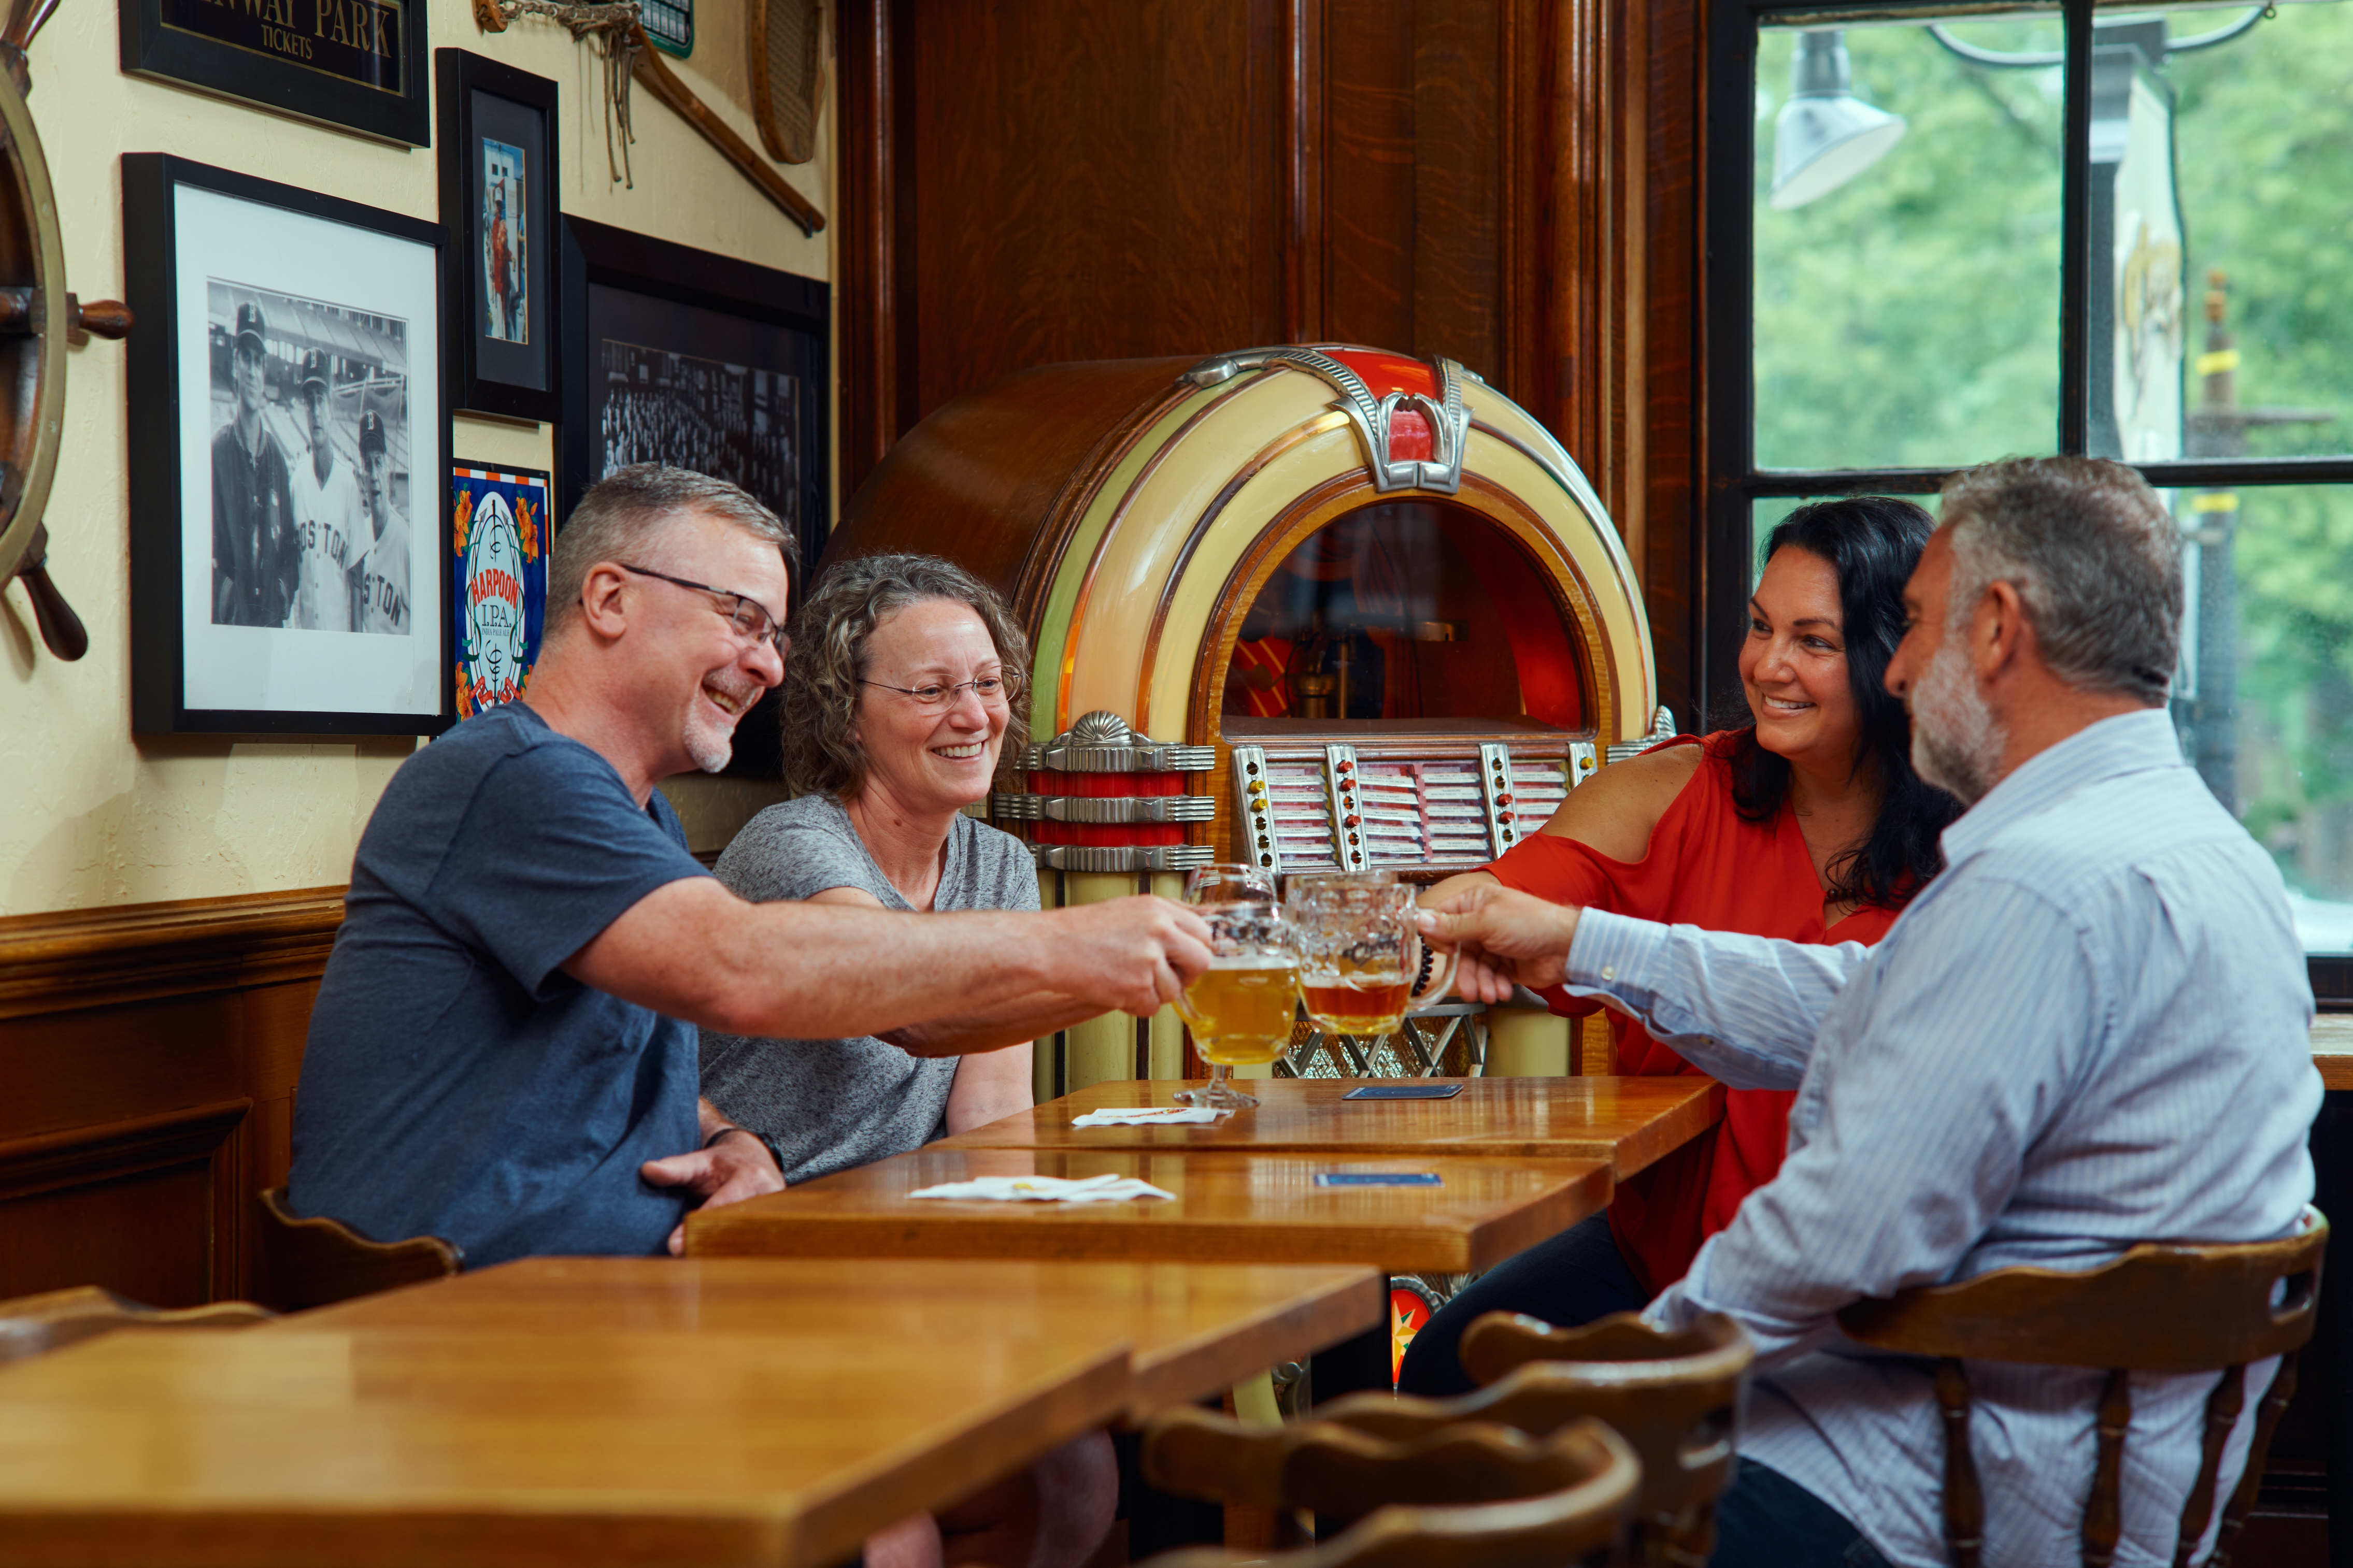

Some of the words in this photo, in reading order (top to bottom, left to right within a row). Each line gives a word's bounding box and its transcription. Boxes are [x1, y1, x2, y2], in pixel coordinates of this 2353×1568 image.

[261, 24, 312, 60] TICKETS
[314, 0, 391, 59] PARK
[363, 573, 401, 627] STON
[470, 568, 519, 610] HARPOON
[482, 604, 512, 627] I.P.A.
